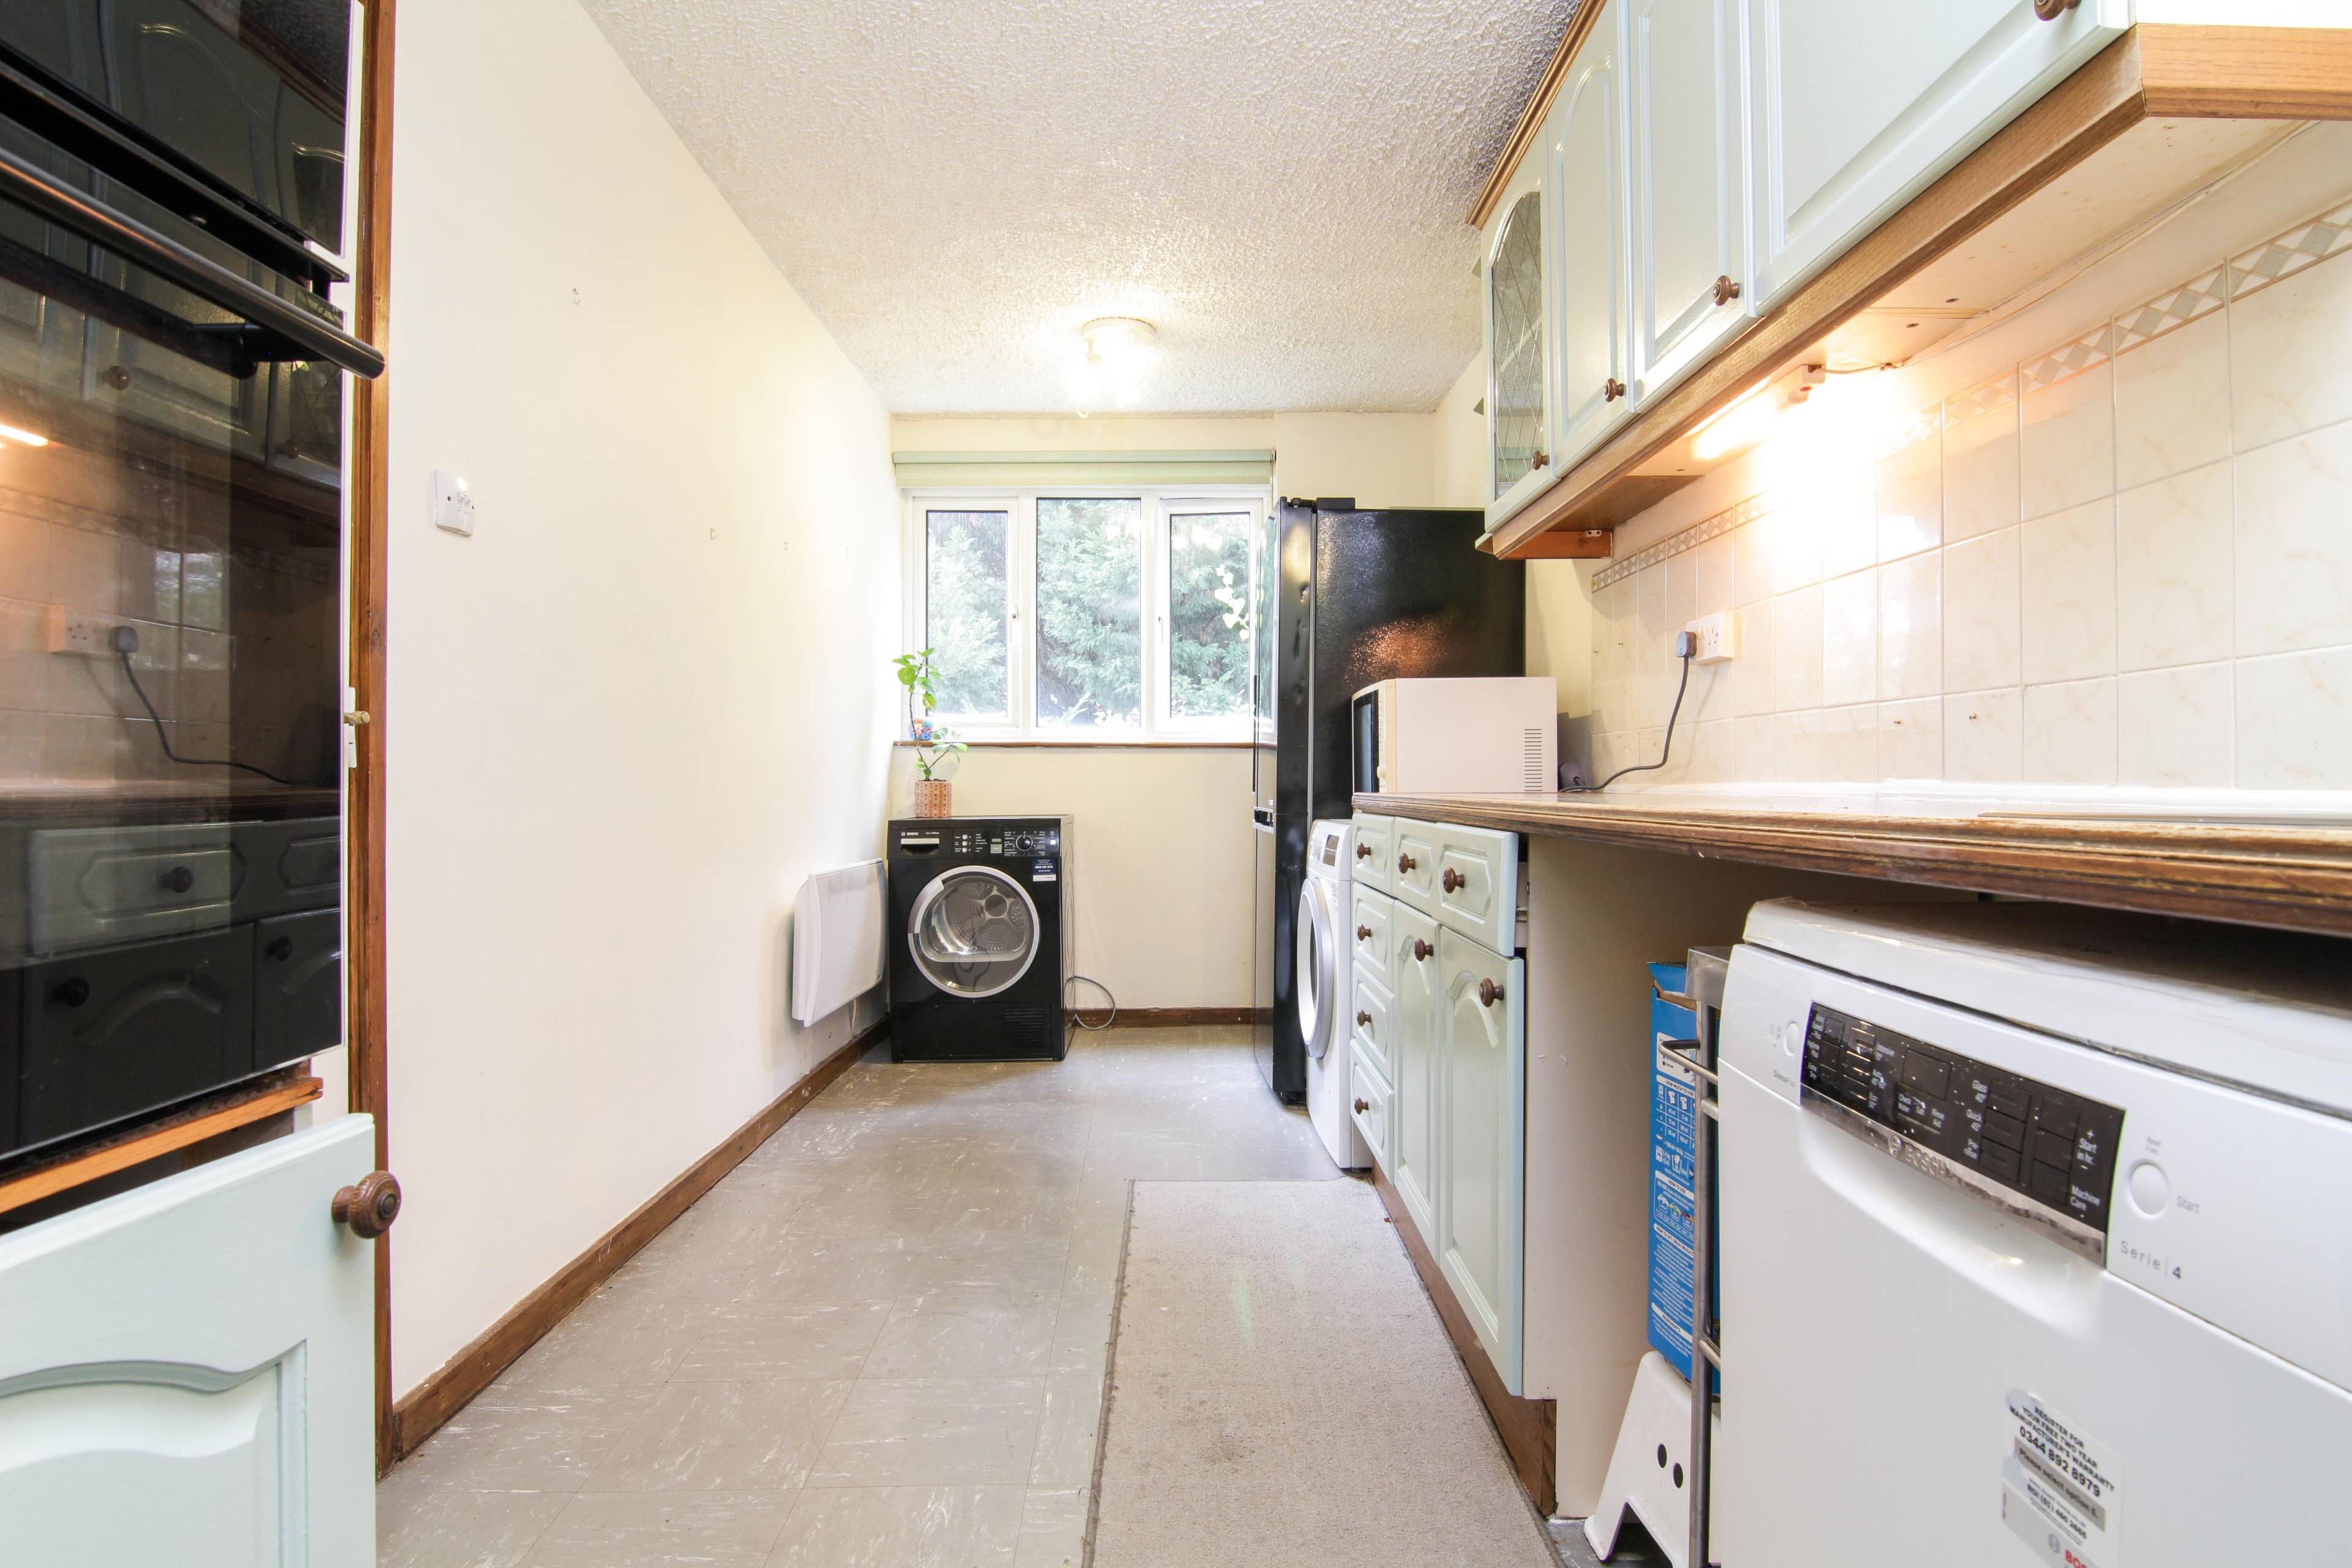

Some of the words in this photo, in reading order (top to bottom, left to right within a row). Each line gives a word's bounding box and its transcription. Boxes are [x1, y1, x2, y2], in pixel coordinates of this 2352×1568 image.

[1673, 1082, 1683, 1093] MUCH
[1972, 1079, 1988, 1093] Glass
[1966, 1109, 1983, 1123] Quick
[2079, 1138, 2098, 1154] Start
[1904, 1142, 1948, 1181] BOSCH
[2070, 1196, 2087, 1212] Care
[2071, 1185, 2101, 1206] Machine
[2176, 1195, 2201, 1215] Start
[2120, 1240, 2162, 1270] Serie
[2172, 1267, 2182, 1280] 4
[2022, 1406, 2040, 1425] YOUR
[2041, 1421, 2059, 1439] FREE
[2060, 1435, 2077, 1453] TWO
[2078, 1449, 2098, 1469] YEAR
[2035, 1406, 2069, 1437] REGISTER
[2070, 1433, 2084, 1449] FOR
[2010, 1404, 2070, 1458] MANUFACTURER'S
[2071, 1454, 2114, 1492] WARRANTY
[2020, 1426, 2046, 1454] 0344
[2048, 1448, 2069, 1473] 892
[2071, 1467, 2101, 1498] 8979
[2019, 1447, 2041, 1471] Please
[2043, 1469, 2064, 1490] select
[2065, 1488, 2089, 1511] option
